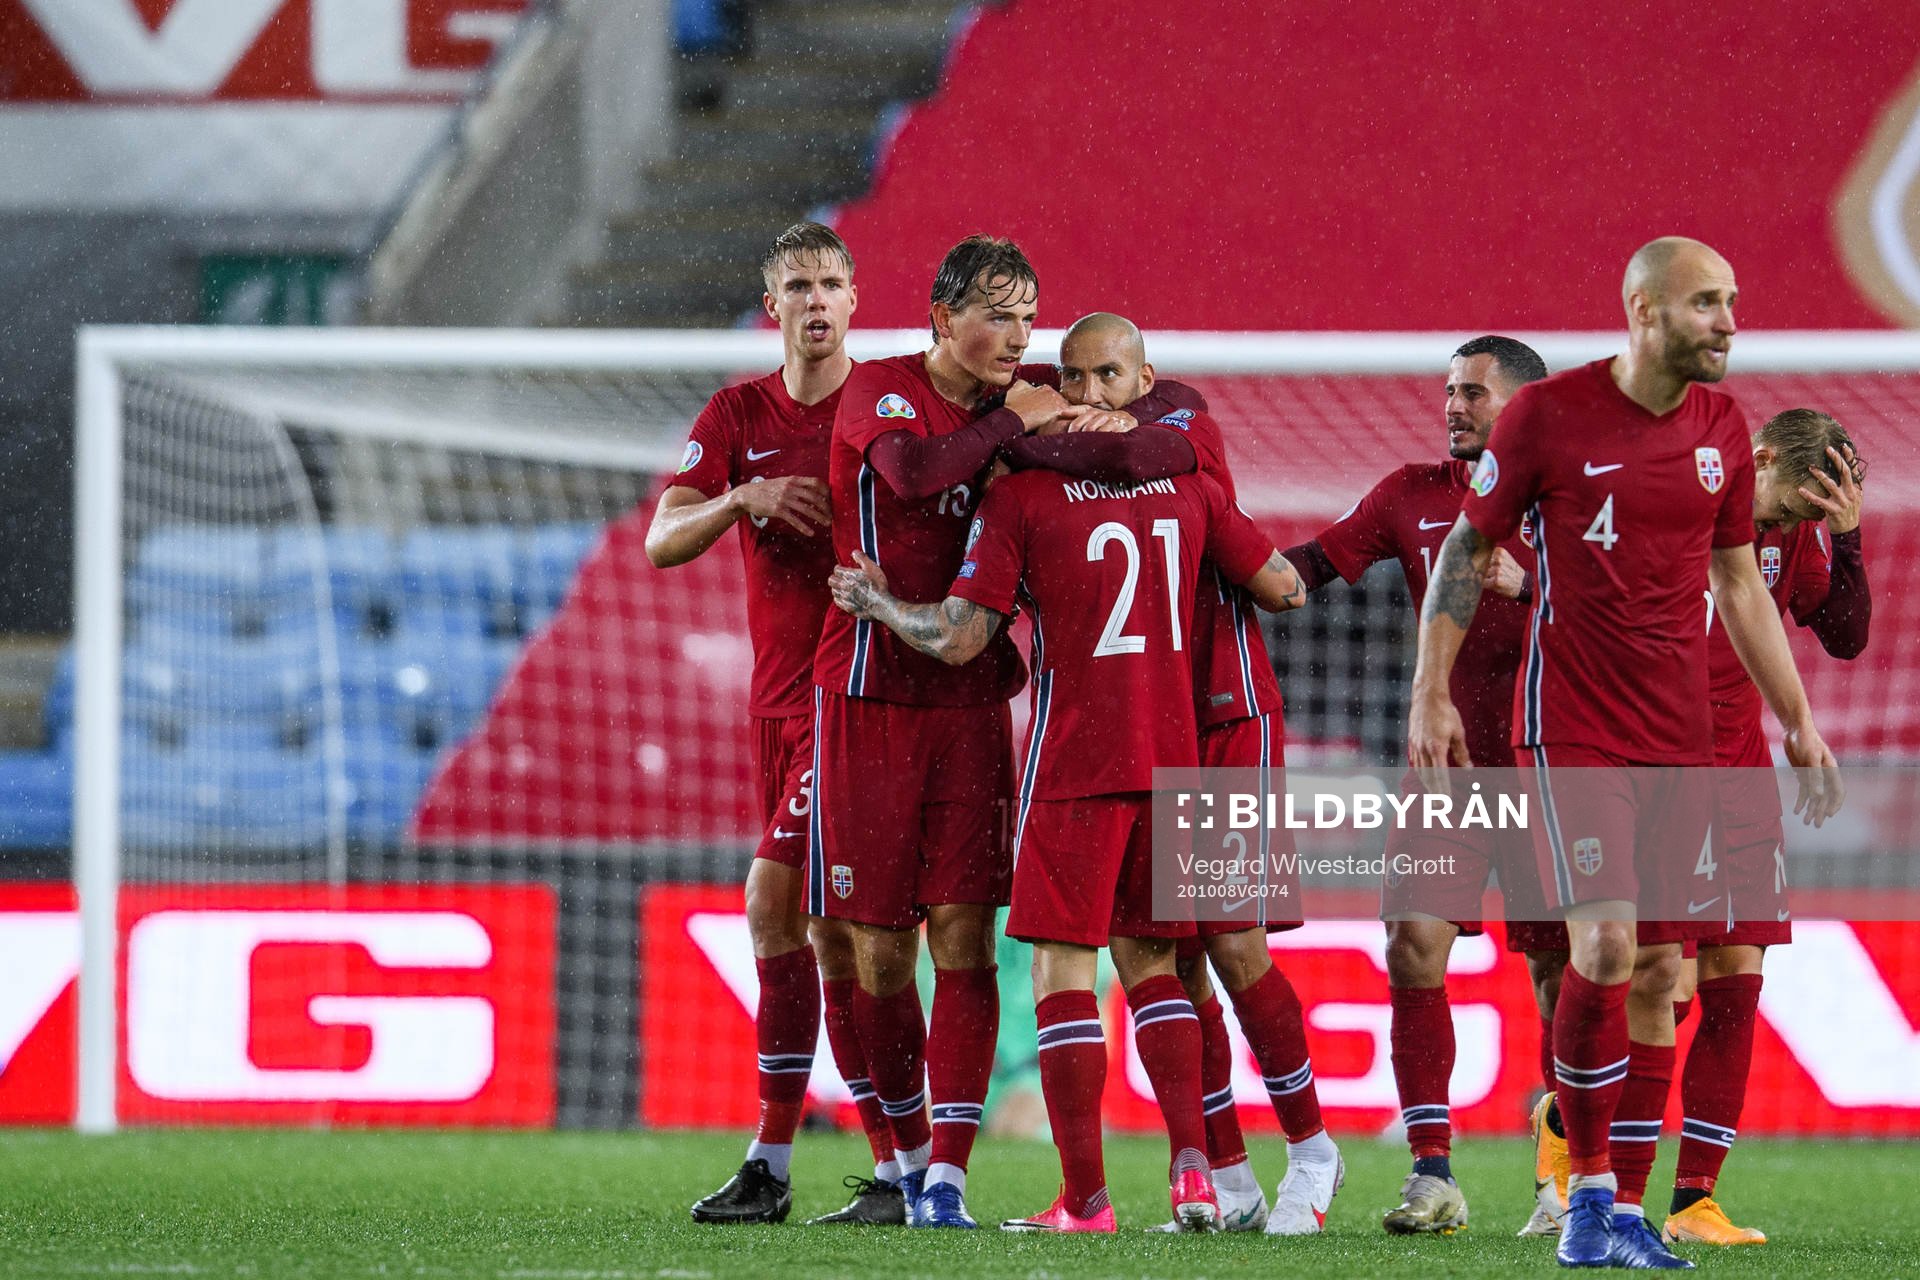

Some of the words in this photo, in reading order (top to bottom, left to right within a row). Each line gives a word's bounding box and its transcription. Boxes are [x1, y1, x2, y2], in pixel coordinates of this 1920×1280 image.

[1154, 418, 1189, 431] ESPECT
[1063, 478, 1177, 502] NORMANN
[1582, 493, 1619, 550] 4
[1087, 518, 1182, 657] 21
[1222, 831, 1249, 887] 2
[1693, 822, 1718, 881] 4
